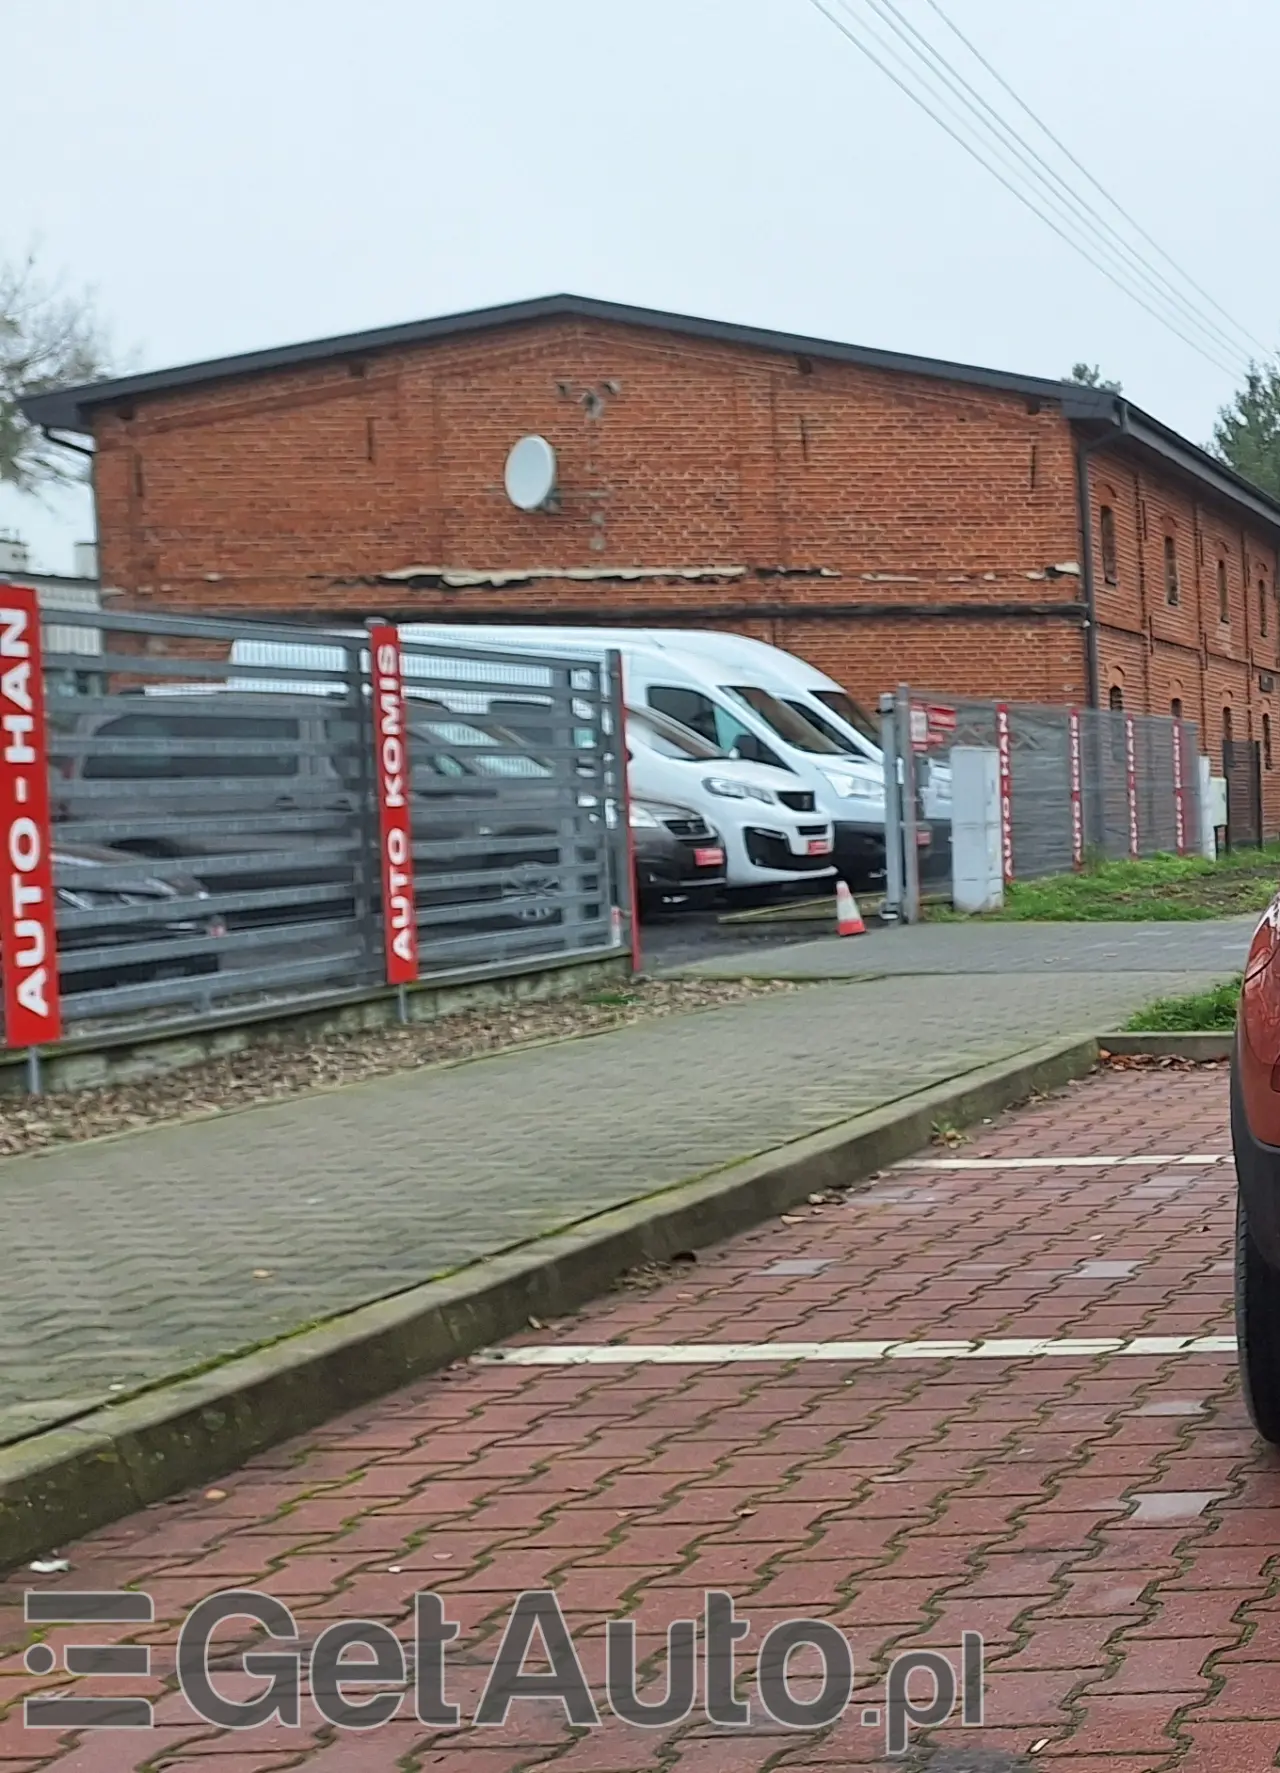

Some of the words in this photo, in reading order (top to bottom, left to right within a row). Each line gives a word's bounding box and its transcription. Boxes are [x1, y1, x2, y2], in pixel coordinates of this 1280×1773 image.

[0, 608, 36, 764] HAN
[378, 643, 405, 808] KOMIS
[9, 816, 49, 1018] AUTO
[387, 827, 413, 962] AUTO
